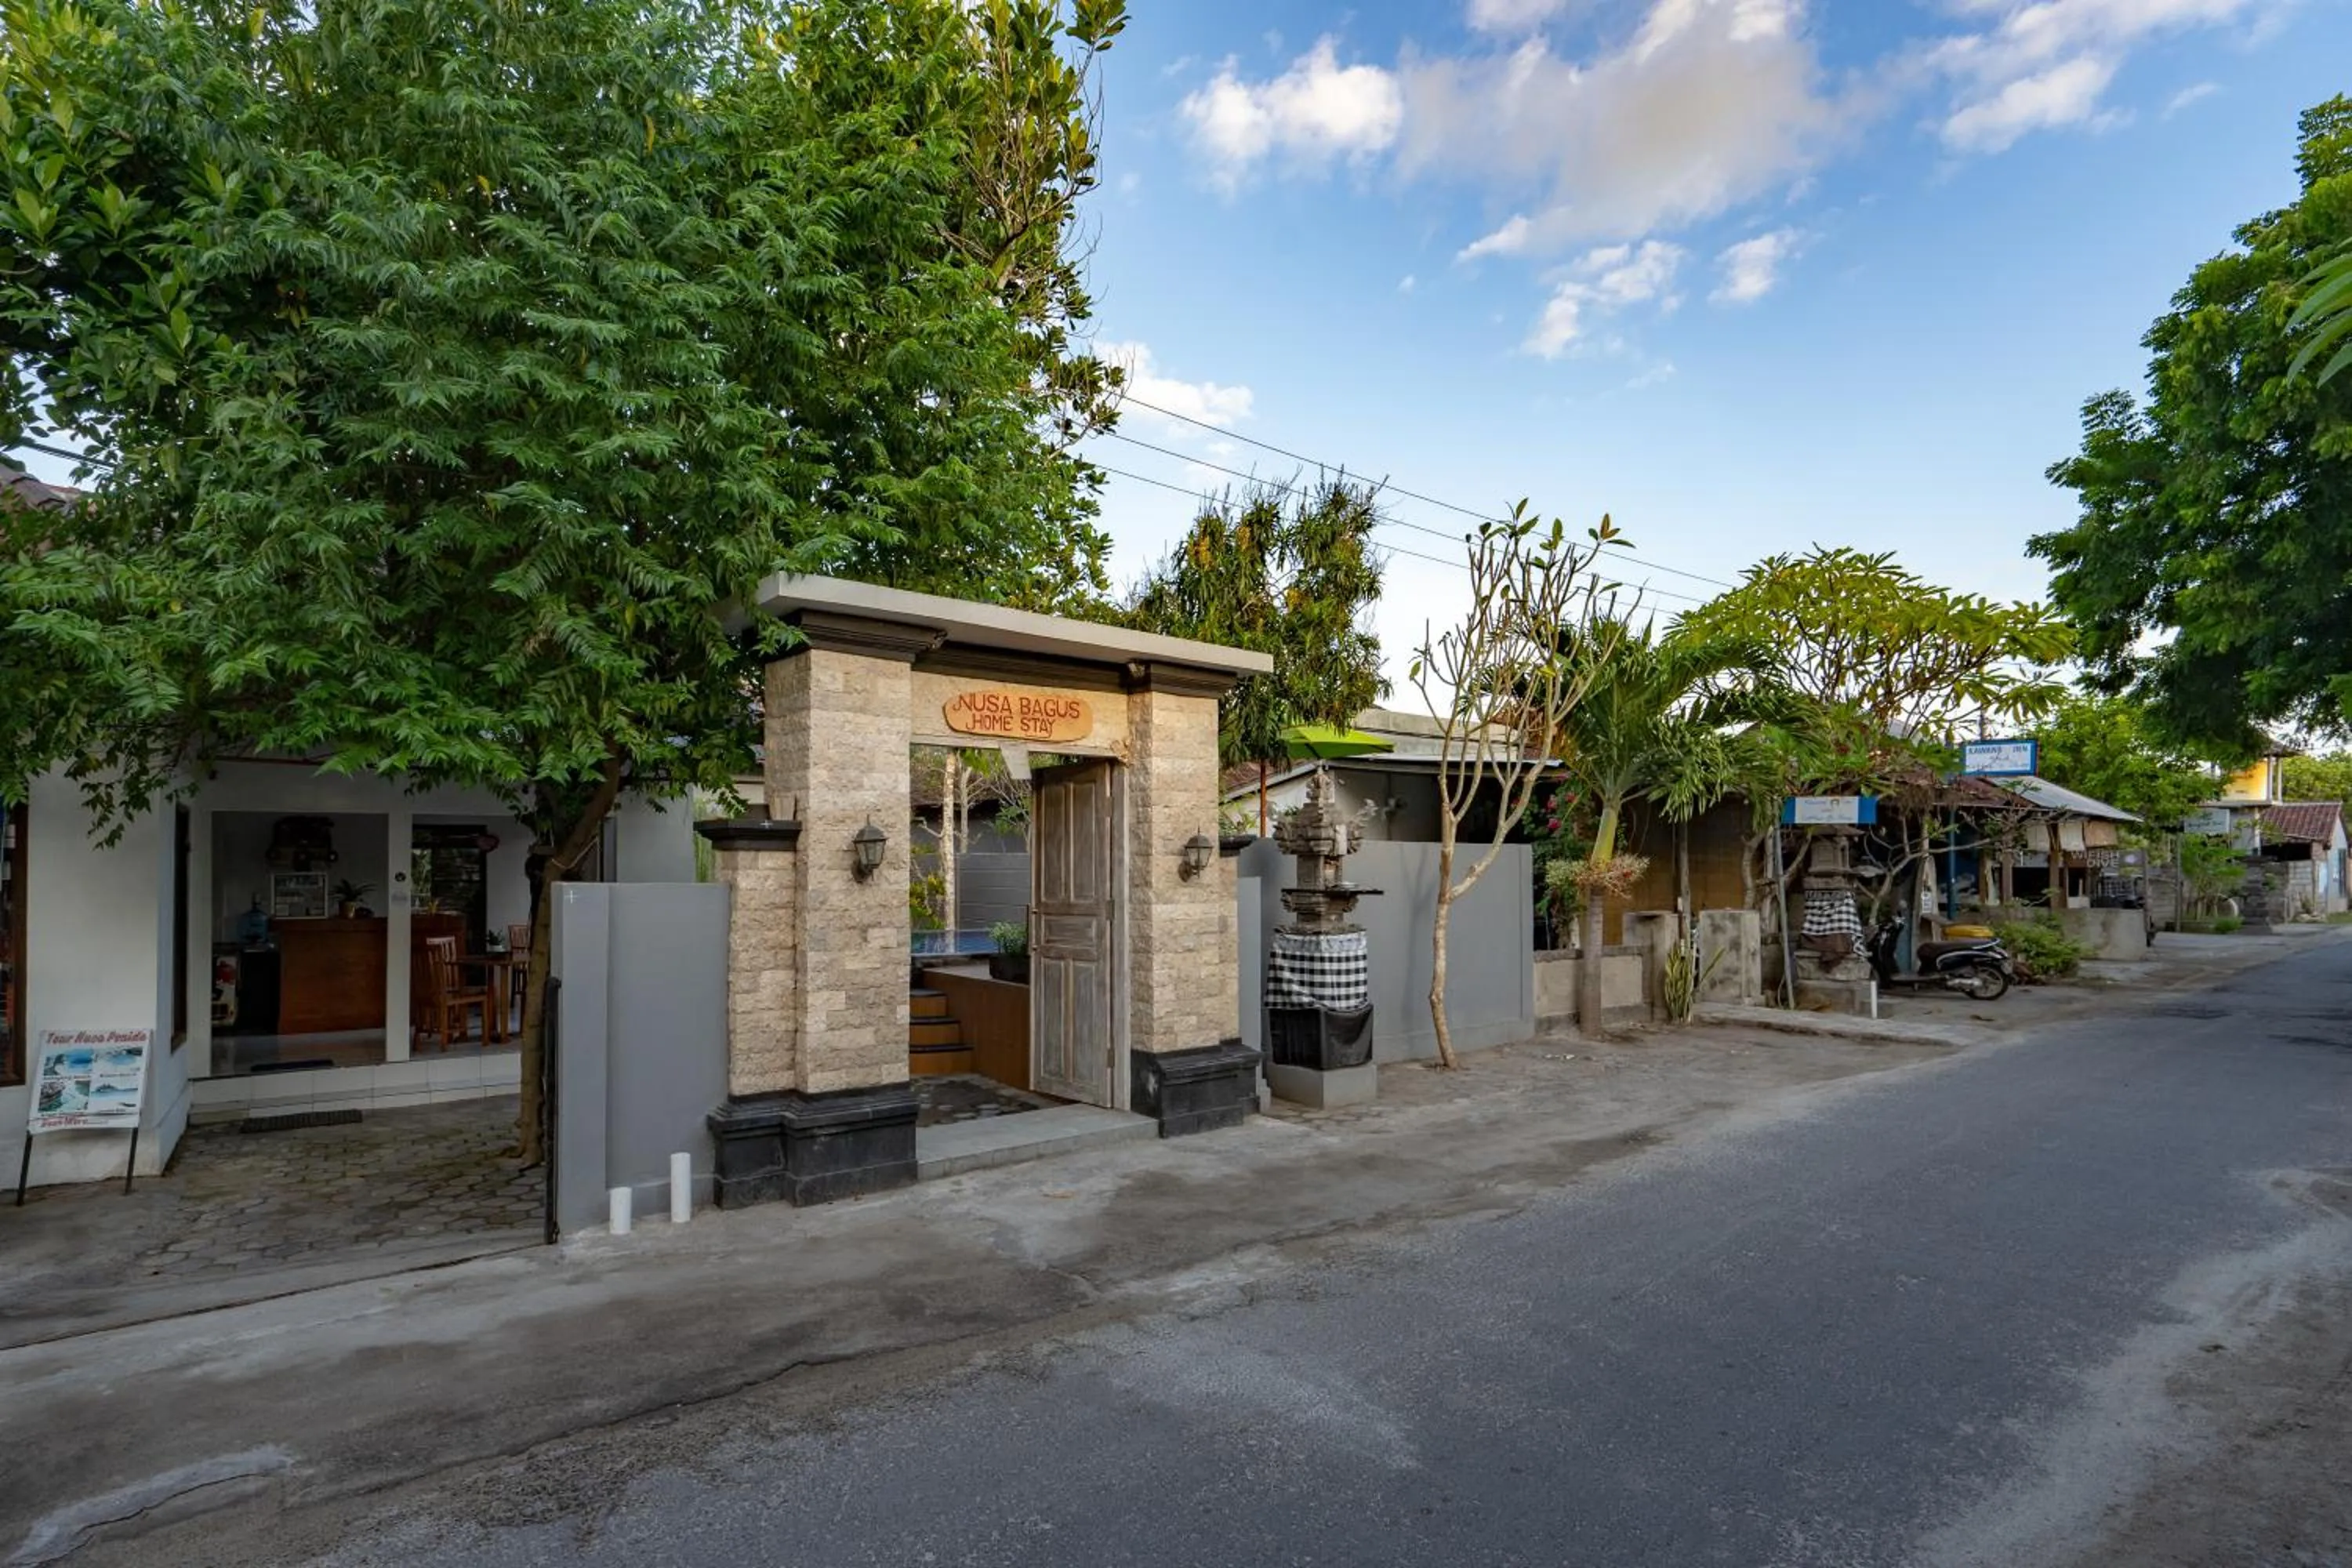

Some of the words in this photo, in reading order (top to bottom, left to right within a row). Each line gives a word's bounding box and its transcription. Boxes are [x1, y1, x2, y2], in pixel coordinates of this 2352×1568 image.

[953, 692, 1012, 714] NUSA
[1019, 697, 1080, 719] BAGUS
[966, 713, 1014, 731] HOME
[1020, 717, 1056, 739] STAY
[74, 1030, 105, 1044] Nusa
